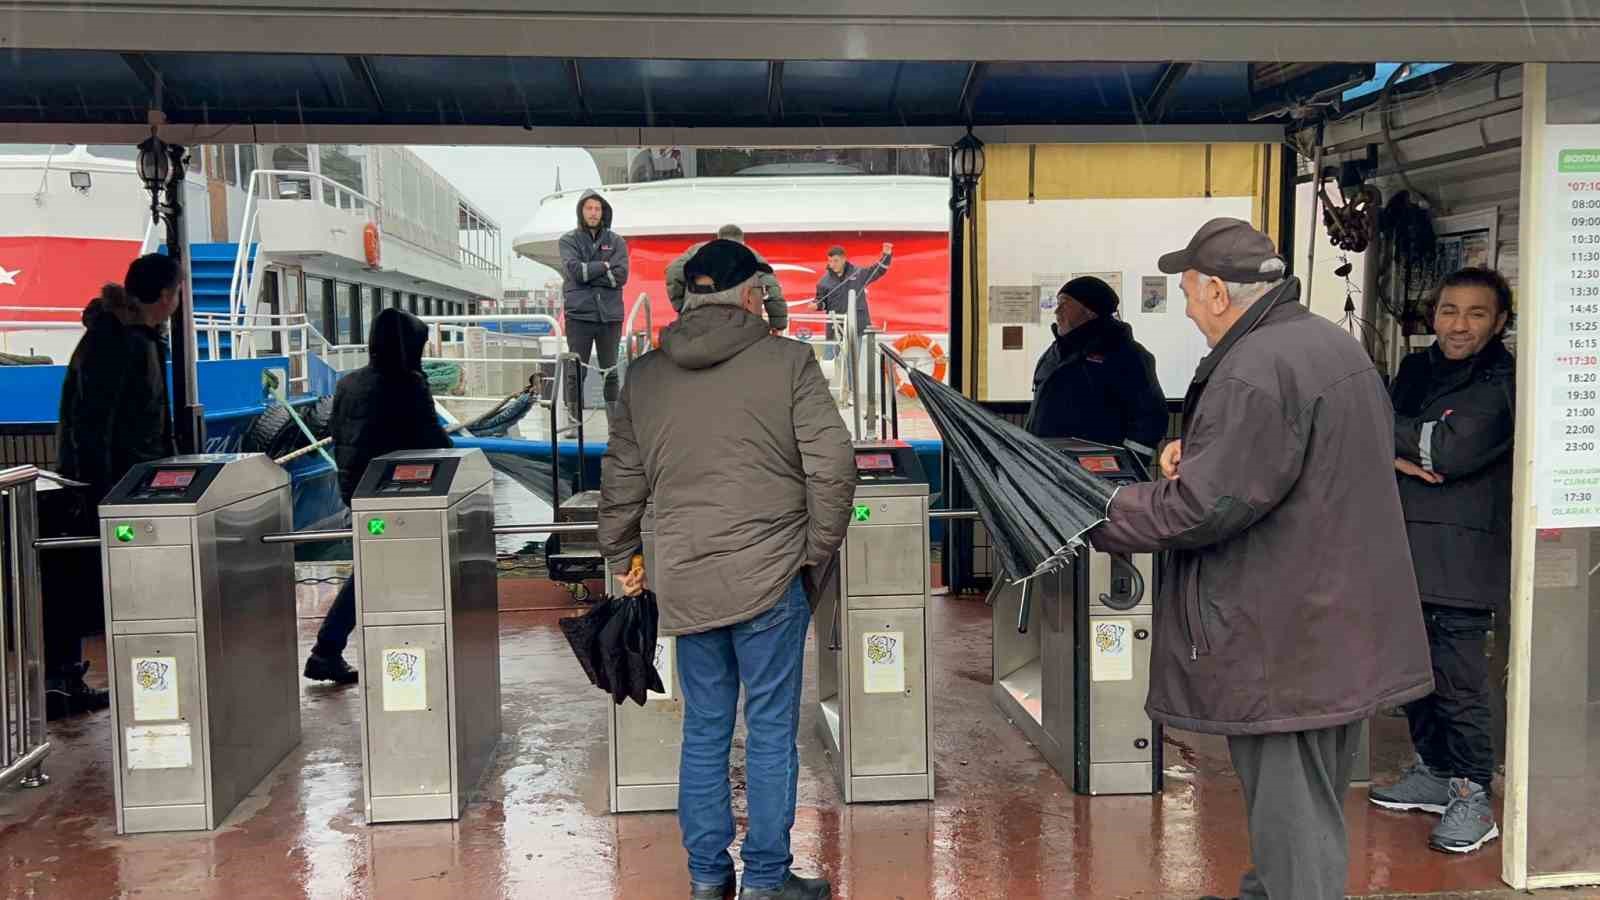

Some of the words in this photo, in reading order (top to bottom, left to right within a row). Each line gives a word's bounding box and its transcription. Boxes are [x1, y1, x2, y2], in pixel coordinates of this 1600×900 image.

[1572, 200, 1600, 208] 08:00
[1571, 217, 1600, 226] 09:00
[1572, 235, 1600, 244] 10:30
[1572, 252, 1599, 261] 11:30
[1571, 270, 1599, 278] 12:30
[1570, 287, 1599, 296] 13:30
[1570, 304, 1598, 313] 14:45
[1569, 321, 1598, 331] 15:25
[1569, 339, 1598, 348] 16:15
[1568, 373, 1597, 382] 18:20
[1568, 391, 1596, 400] 19:30
[1566, 408, 1595, 417] 21:00
[1566, 425, 1595, 434] 22:00
[1565, 442, 1594, 451] 23:00
[1564, 493, 1592, 502] 17:30
